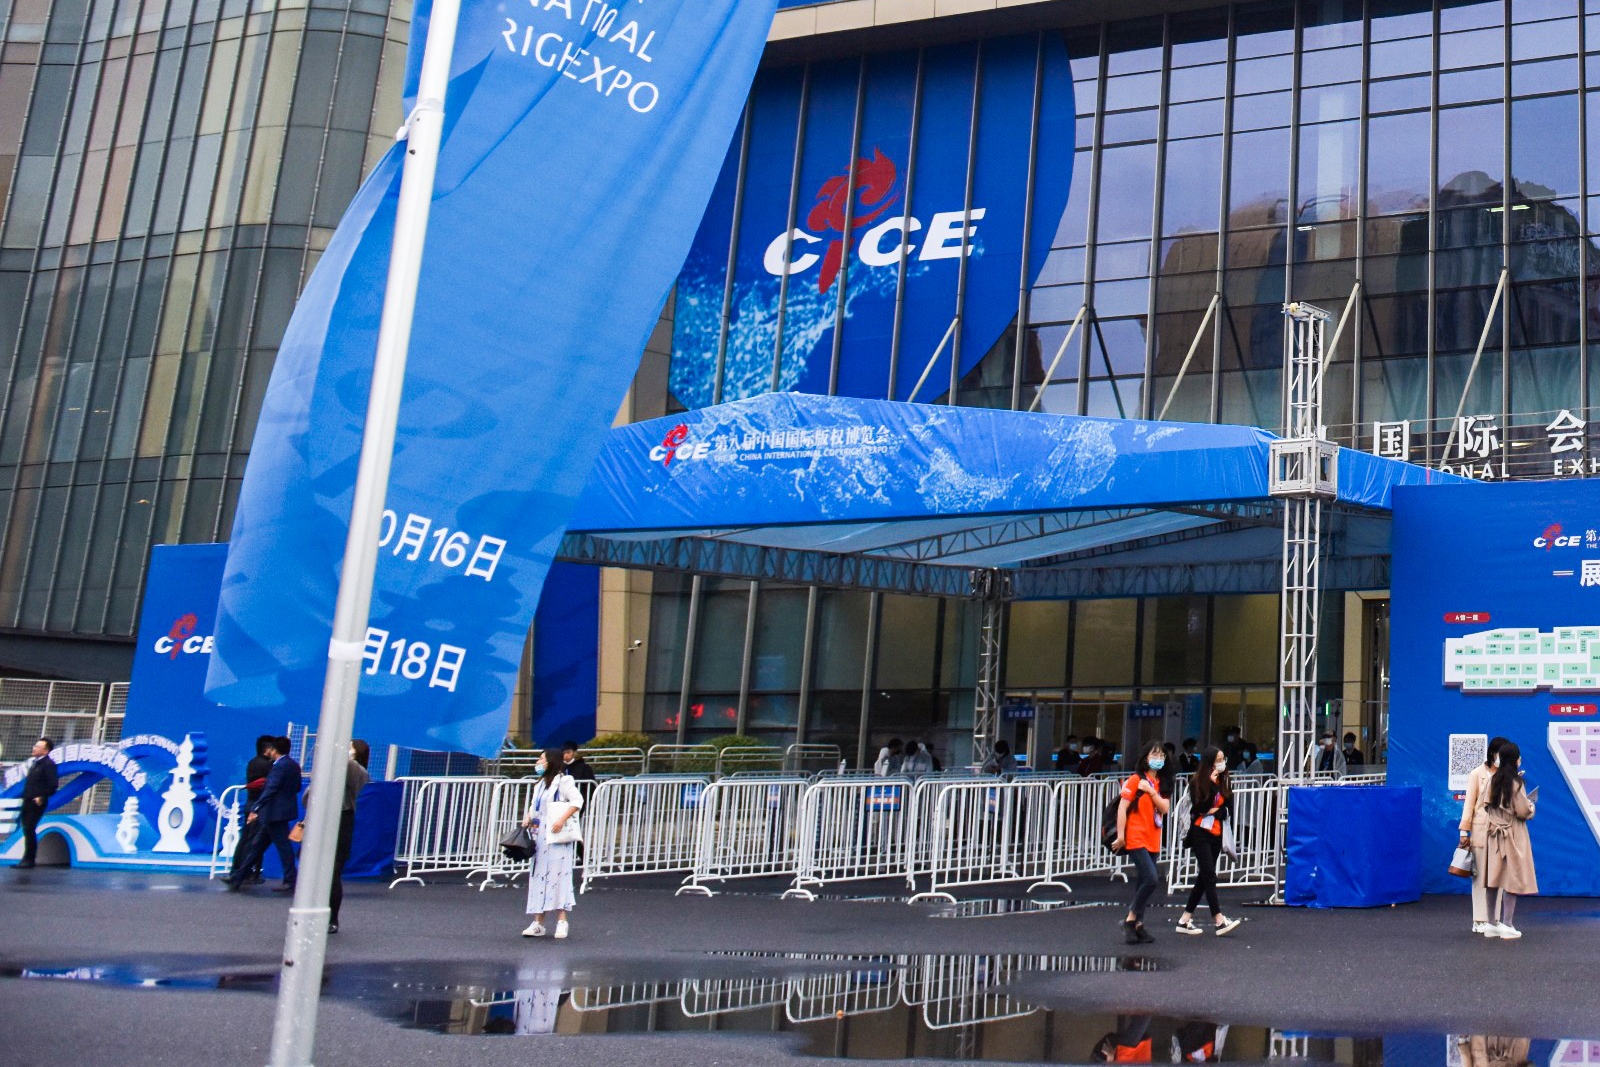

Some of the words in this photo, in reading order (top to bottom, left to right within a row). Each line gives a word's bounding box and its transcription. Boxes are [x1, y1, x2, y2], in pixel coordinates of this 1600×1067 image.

[714, 425, 891, 452] 第八届中国国际版权博览会
[740, 452, 762, 461] CHINA
[764, 448, 822, 460] INTERNATIONAL
[823, 447, 866, 457] COPYRIGHT
[868, 445, 888, 454] EXPO
